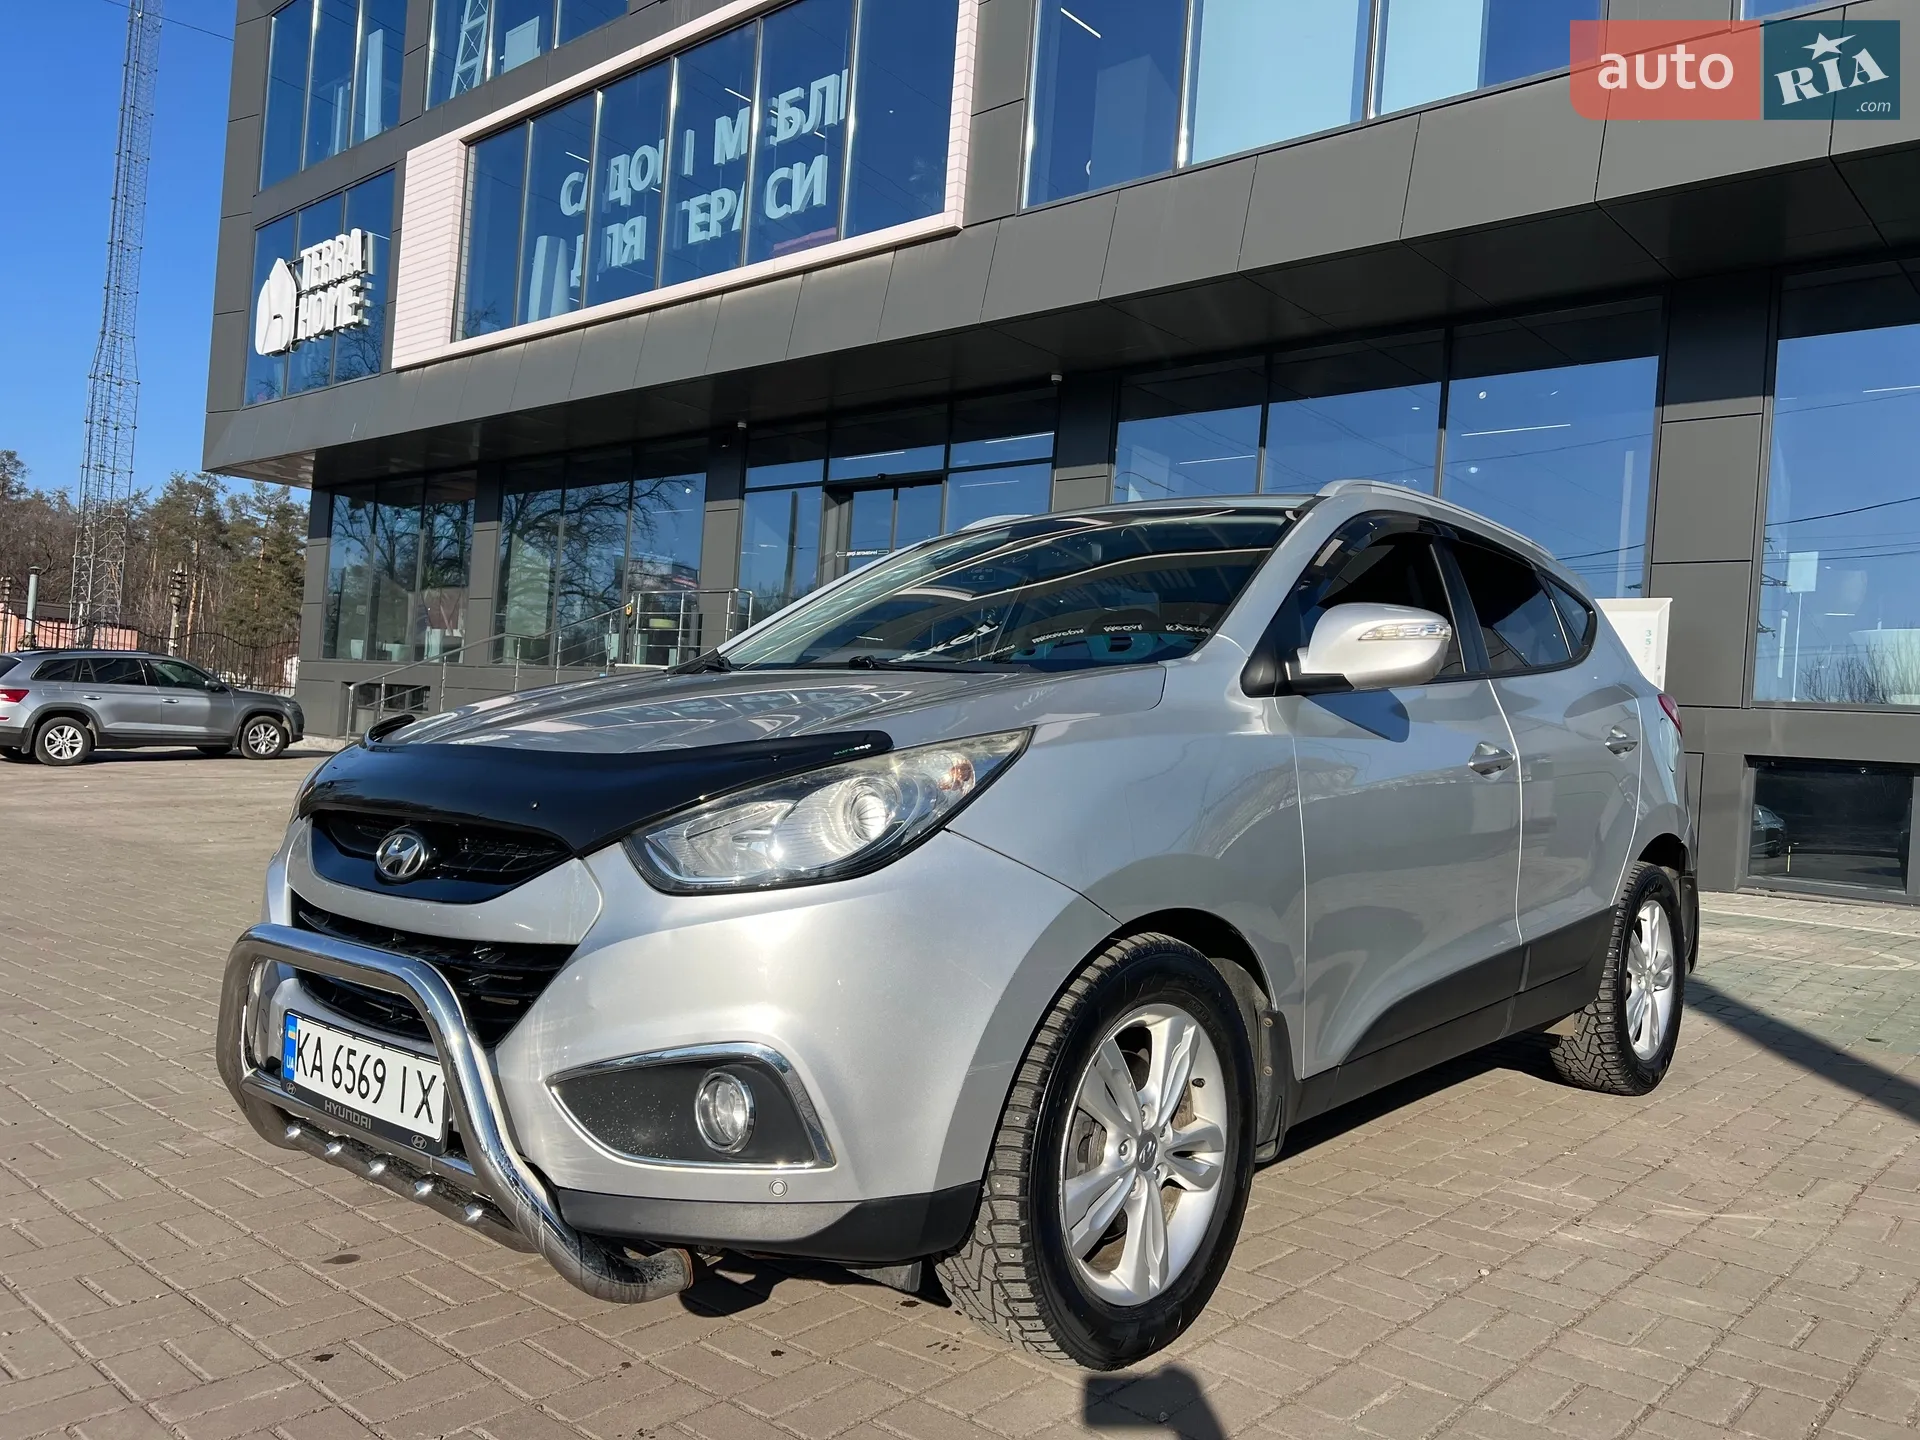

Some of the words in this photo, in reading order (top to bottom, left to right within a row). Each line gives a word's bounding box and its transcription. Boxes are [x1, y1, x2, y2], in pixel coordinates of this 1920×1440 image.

[560, 128, 695, 217] СДОІ
[299, 227, 363, 292] TERRA
[296, 278, 362, 341] HOME
[286, 1054, 295, 1070] UA
[295, 1029, 324, 1083] KA
[331, 1044, 387, 1104] 6569
[400, 1065, 437, 1124] IX
[324, 1099, 372, 1130] HYUNDAI
